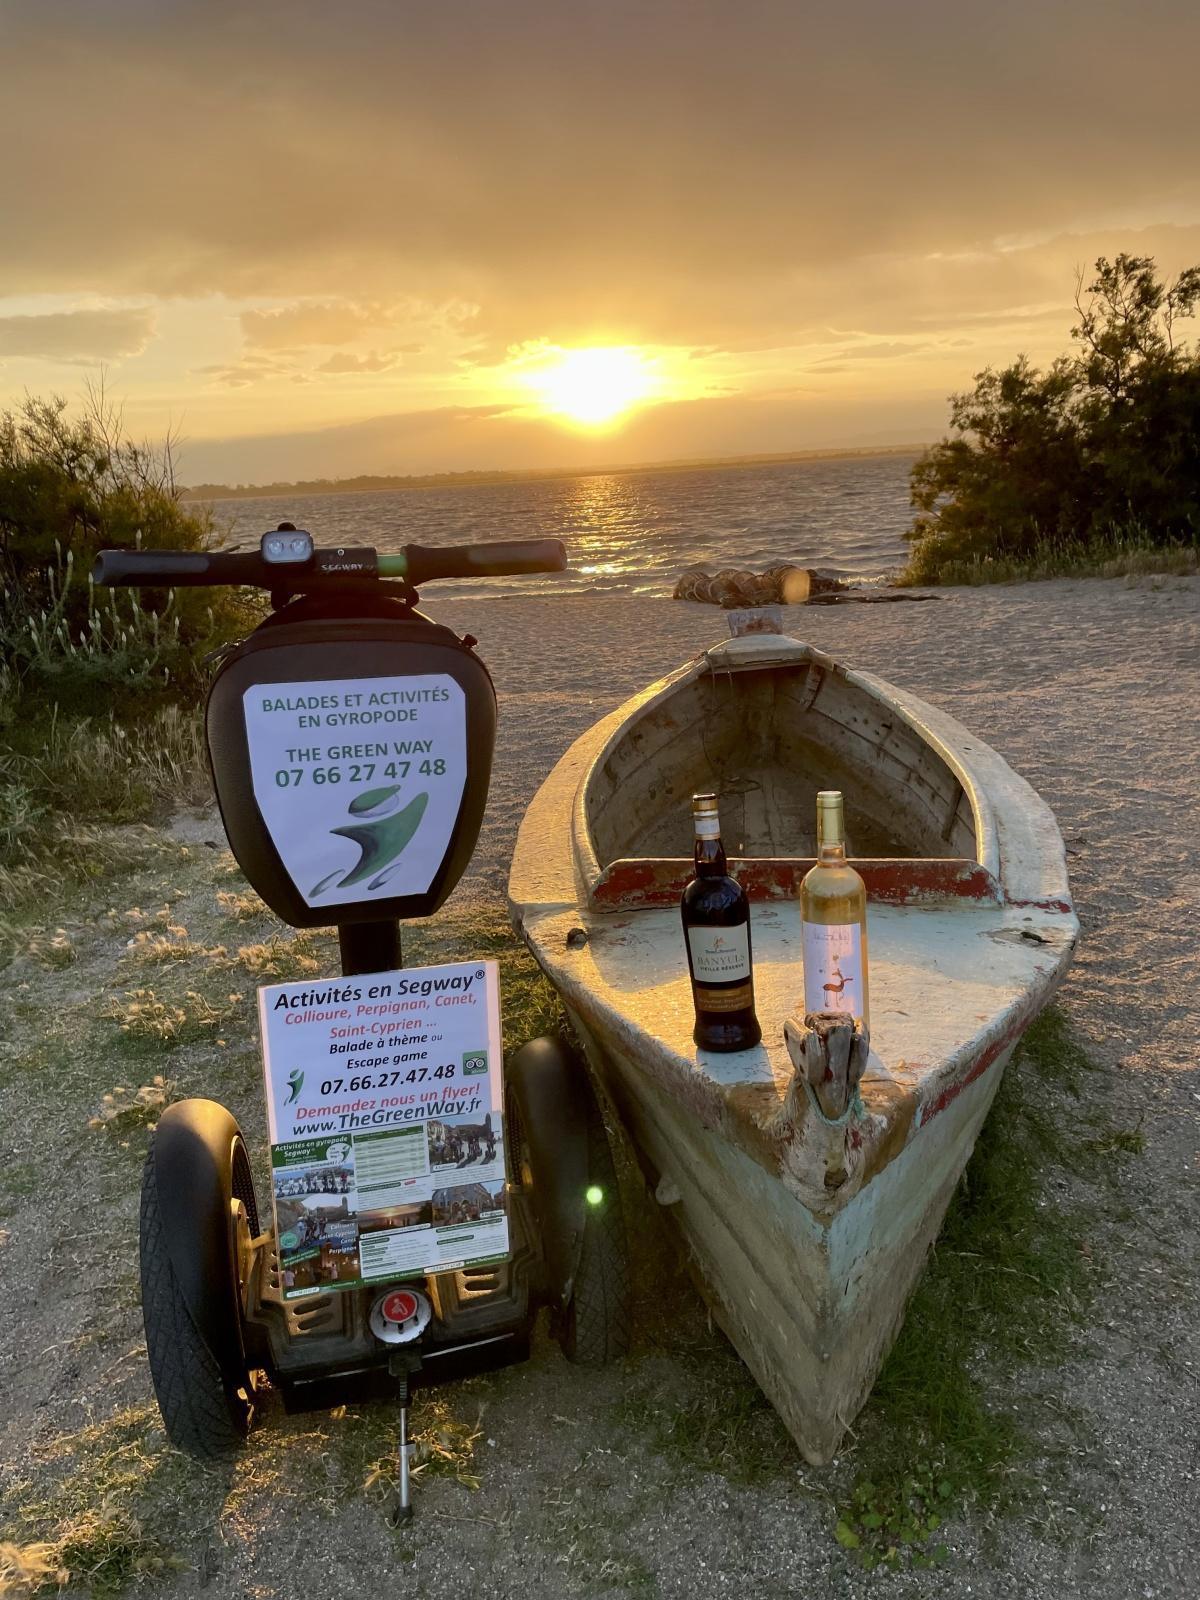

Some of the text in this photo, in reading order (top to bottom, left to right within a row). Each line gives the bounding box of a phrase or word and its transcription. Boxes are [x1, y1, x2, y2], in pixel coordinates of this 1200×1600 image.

[262, 686, 449, 712] BALADES ET ACTIVITÉS
[299, 708, 418, 728] EN GYROPODE
[286, 740, 434, 762] THE GREEN WAY
[275, 758, 446, 787] 07 66 27 47 48
[698, 955, 744, 965] BANYULS
[274, 985, 361, 1011] Activités
[368, 985, 391, 999] en
[285, 992, 477, 1025] Collioure, Perpignan, Canet,
[329, 1018, 422, 1039] Saint-Cyprien
[329, 1033, 443, 1055] Balade à thème ou
[347, 1051, 428, 1070] Escape game
[320, 1064, 456, 1096] 07.66.27.47.48
[296, 1083, 481, 1120] Demandez nous un flyer!
[292, 1098, 482, 1136] www.TheGreenWay.fr
[275, 1141, 305, 1152] Activités
[316, 1136, 348, 1147] gyropode
